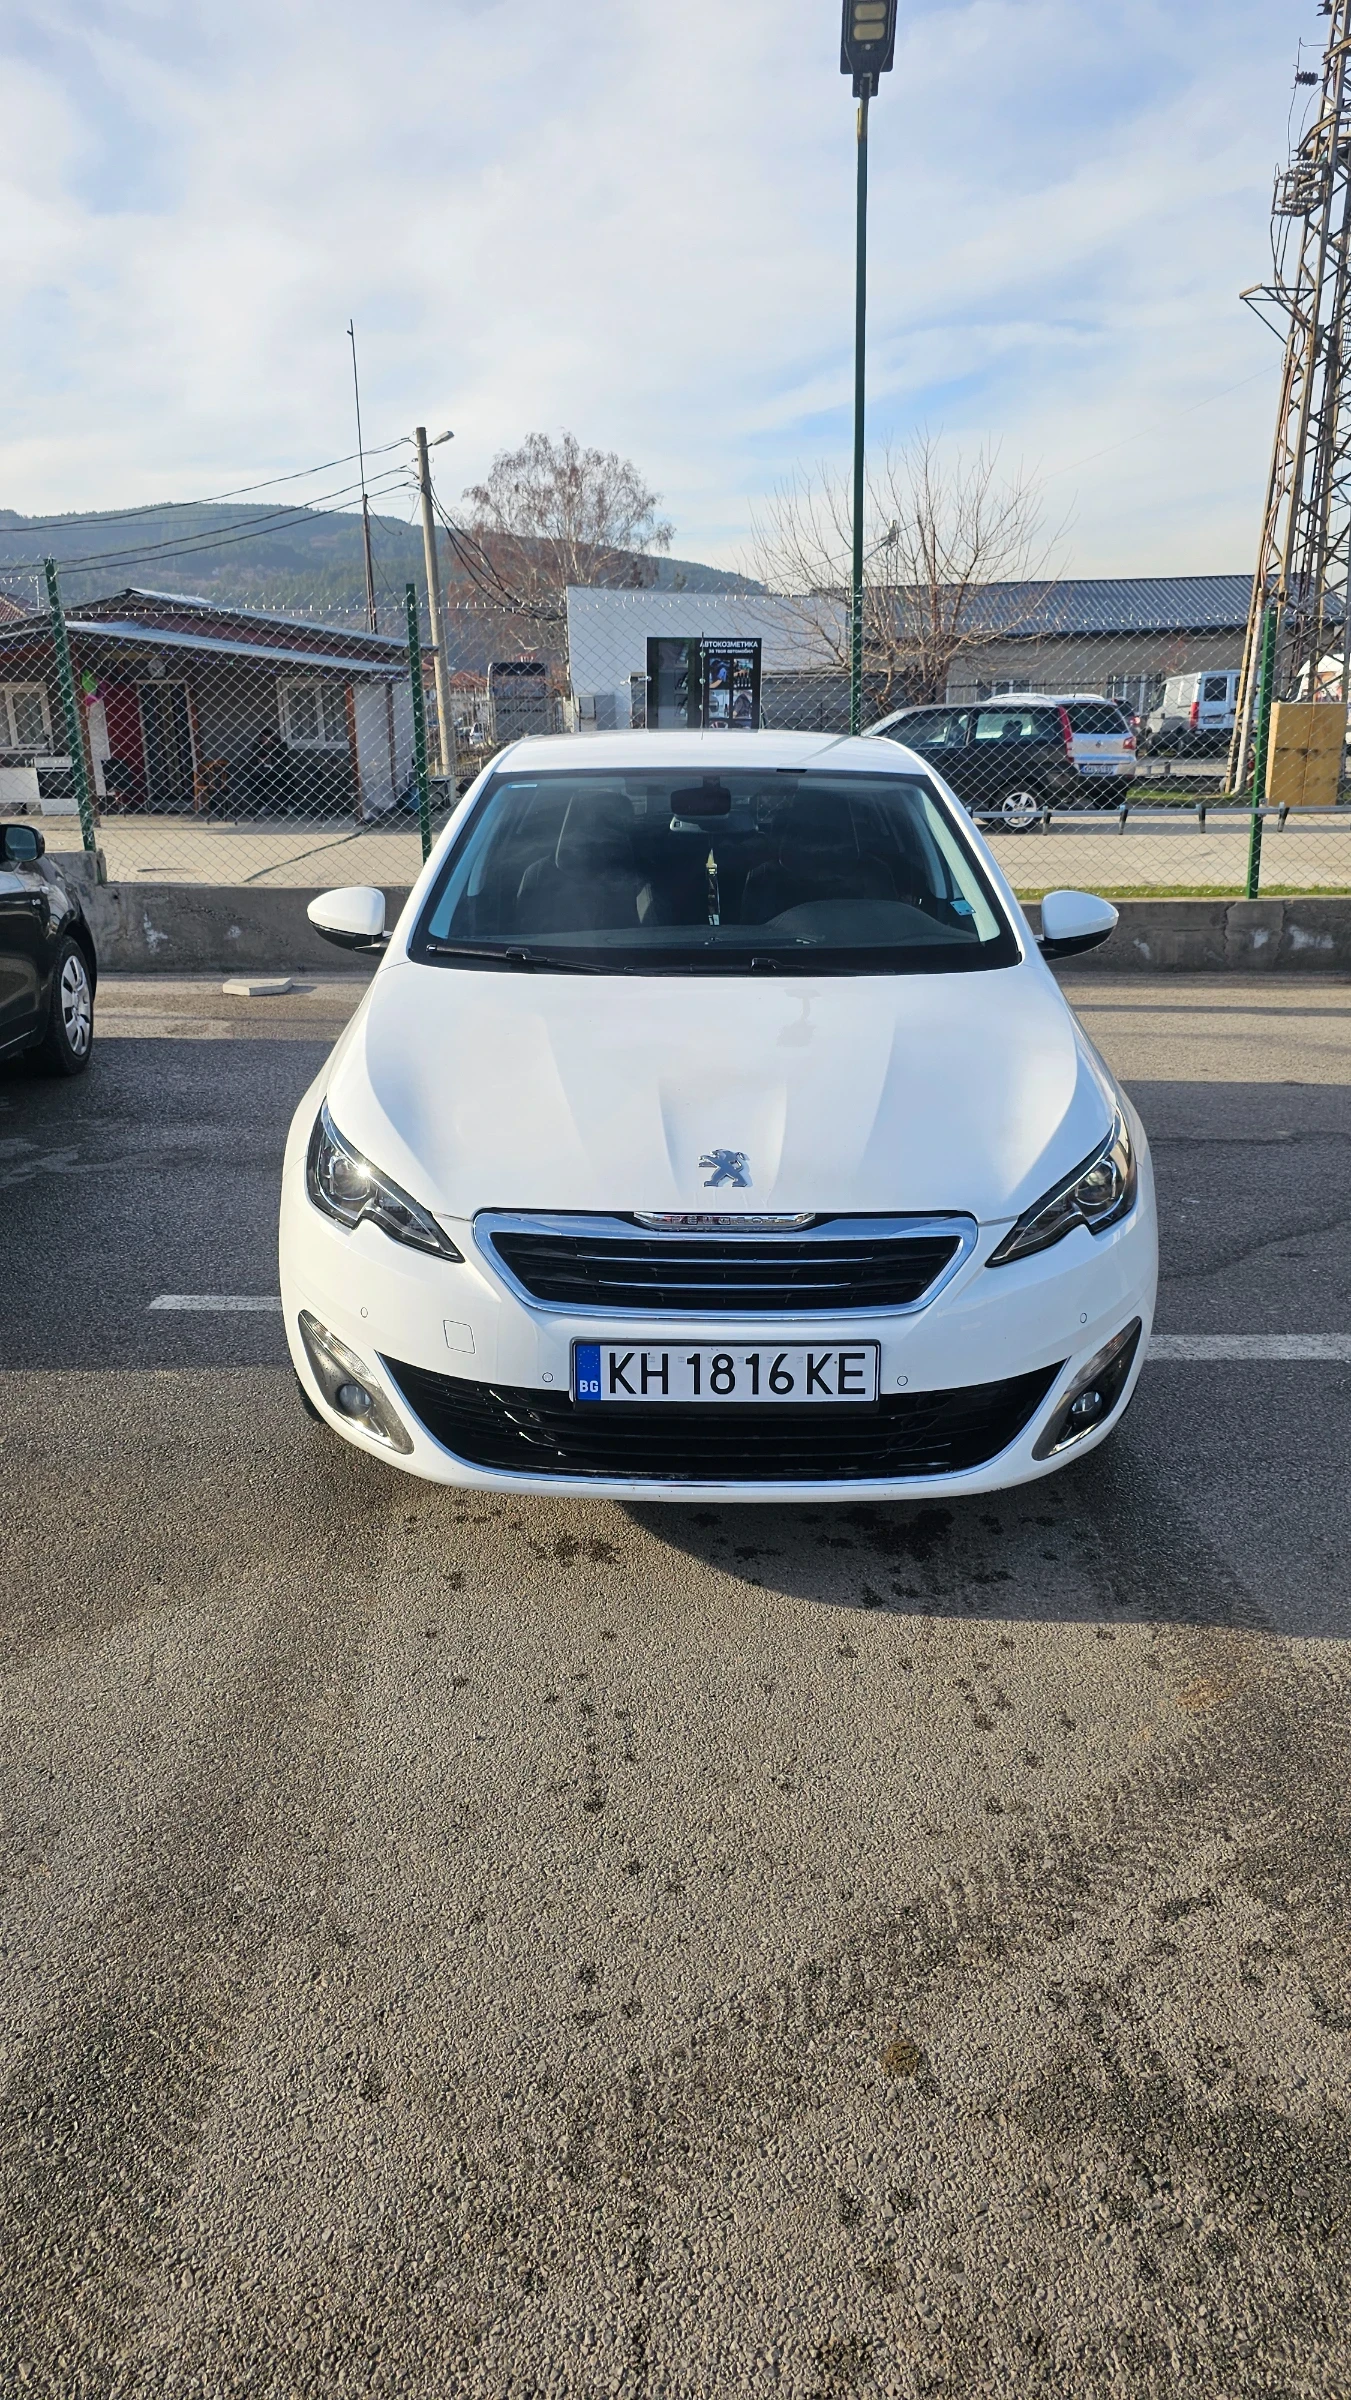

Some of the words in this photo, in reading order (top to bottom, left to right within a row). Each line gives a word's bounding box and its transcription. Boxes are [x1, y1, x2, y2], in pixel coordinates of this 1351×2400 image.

[579, 1380, 599, 1393] BG
[609, 1352, 669, 1395] KH
[686, 1352, 795, 1395] 1816
[806, 1352, 866, 1395] KE
